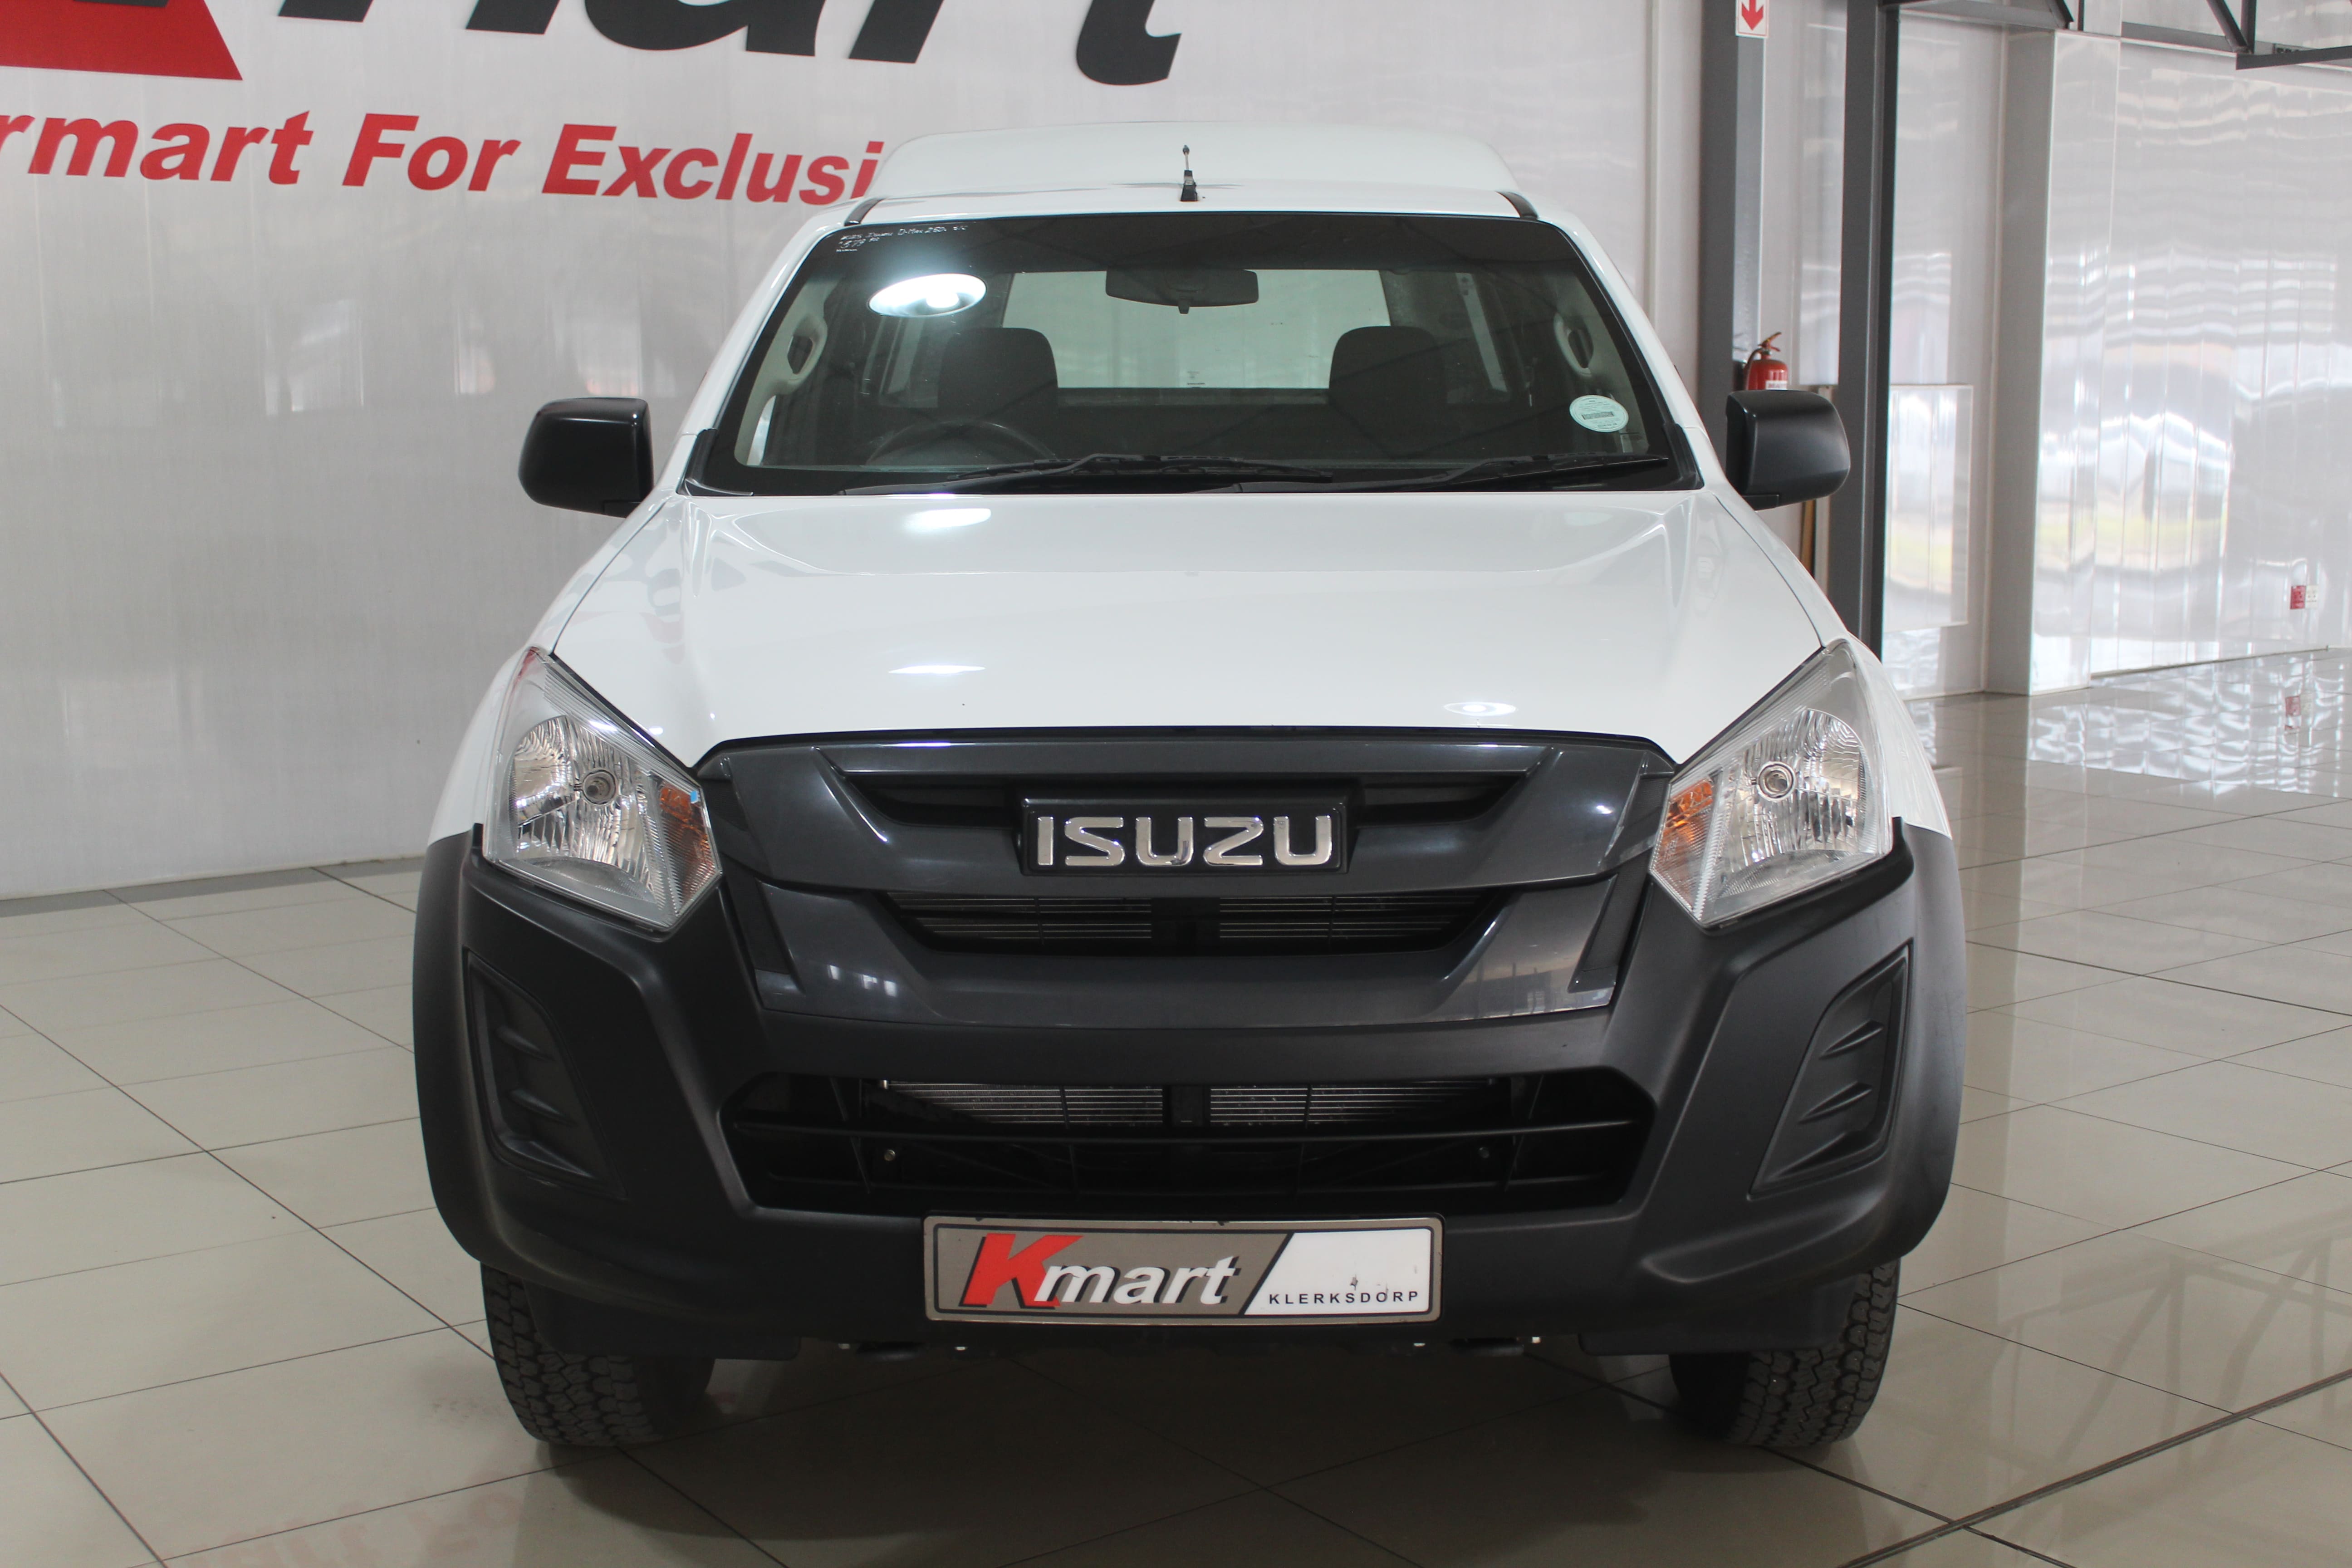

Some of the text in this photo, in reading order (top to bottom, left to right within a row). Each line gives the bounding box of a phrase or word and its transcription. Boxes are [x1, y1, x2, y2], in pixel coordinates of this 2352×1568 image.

[342, 113, 521, 191] For
[542, 123, 885, 206] Exclusi
[1037, 816, 1333, 866] ISUZU
[959, 1232, 1418, 1309] Kmart KLERKSDORP
